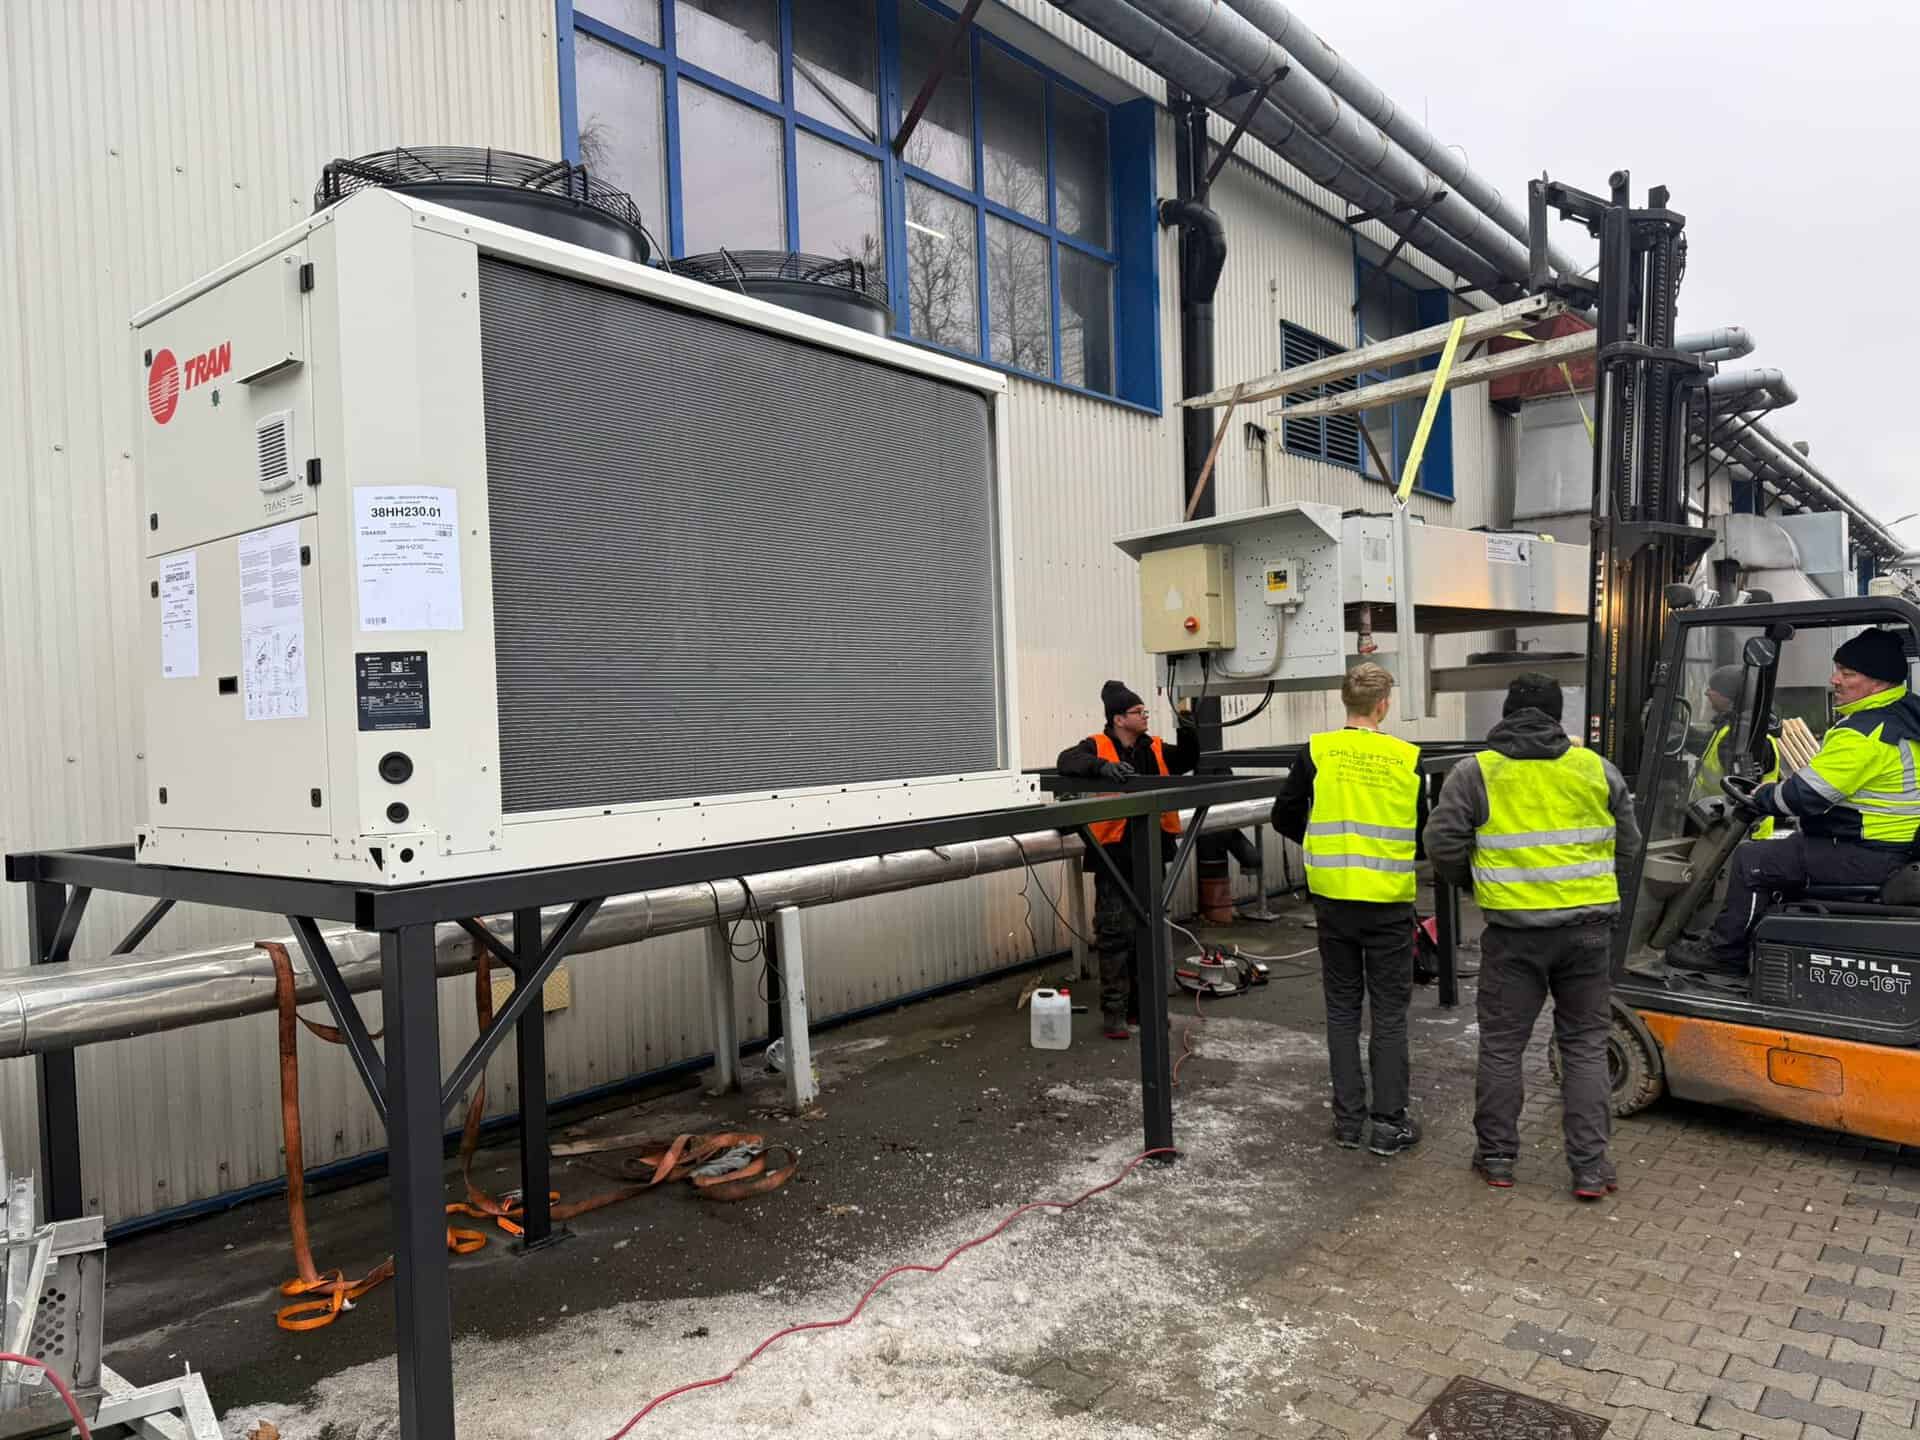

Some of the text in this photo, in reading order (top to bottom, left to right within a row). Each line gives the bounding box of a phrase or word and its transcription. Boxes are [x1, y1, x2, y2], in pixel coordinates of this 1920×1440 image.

[184, 340, 231, 391] TRAN
[370, 506, 441, 518] 38HH230.01
[1809, 953, 1912, 976] STILL
[1809, 966, 1912, 995] R 70-16T
